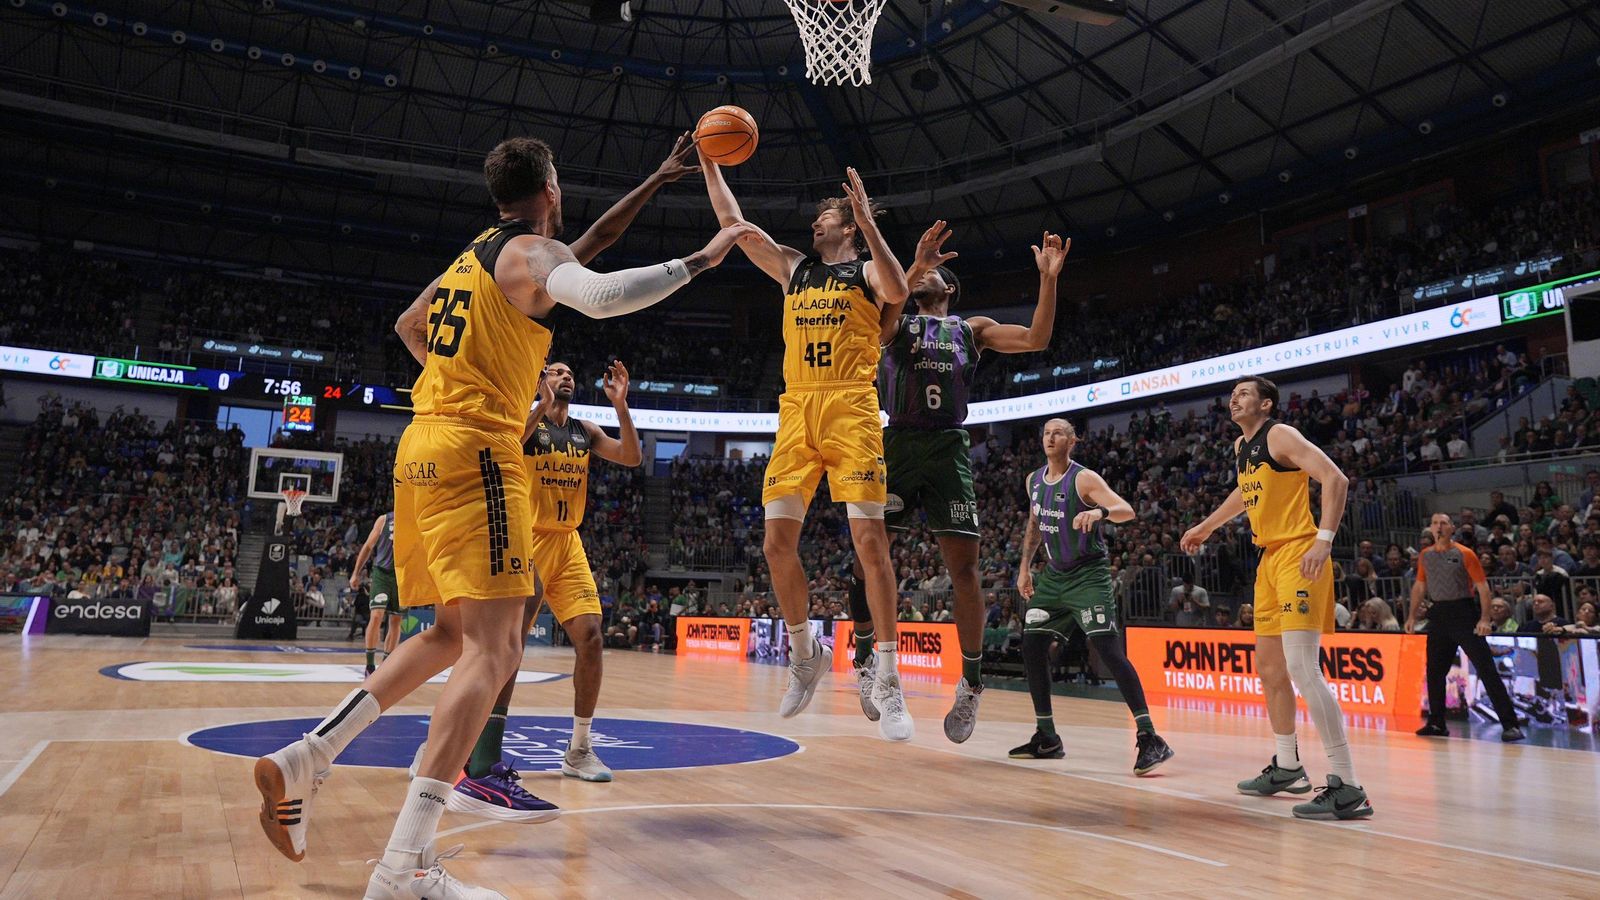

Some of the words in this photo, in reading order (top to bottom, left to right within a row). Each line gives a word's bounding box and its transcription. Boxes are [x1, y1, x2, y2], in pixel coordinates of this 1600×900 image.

[427, 287, 472, 358] 35
[1383, 320, 1431, 339] VIVIR
[804, 342, 832, 367] 42
[1275, 335, 1360, 361] CONSTRUIR
[127, 364, 184, 384] UNICAJA
[1191, 356, 1263, 379] PROMOVER
[218, 372, 230, 390] 0
[263, 378, 302, 396] 7:56
[323, 385, 342, 399] 24
[363, 387, 374, 404] 5
[1131, 372, 1181, 393] ANSAN
[925, 384, 942, 410] 6
[1047, 394, 1077, 407] VIVIR
[289, 406, 312, 422] 24
[569, 410, 637, 421] PROMOR
[970, 401, 1034, 417] CONSTRUIR
[648, 415, 721, 425] CONSTRUIR
[737, 418, 772, 426] VIVIR
[536, 461, 550, 471] LA
[557, 500, 568, 521] 11
[1040, 508, 1065, 520] Unicaja
[54, 602, 142, 620] endesa
[254, 616, 285, 626] Unicaja
[900, 631, 942, 654] FITNESS
[901, 653, 942, 668] MARBELLA
[1163, 640, 1216, 672] JOHN
[1218, 642, 1259, 674] PET
[1319, 646, 1384, 682] NESS
[1164, 671, 1216, 691] TIENDA
[1219, 674, 1264, 695] FITNE
